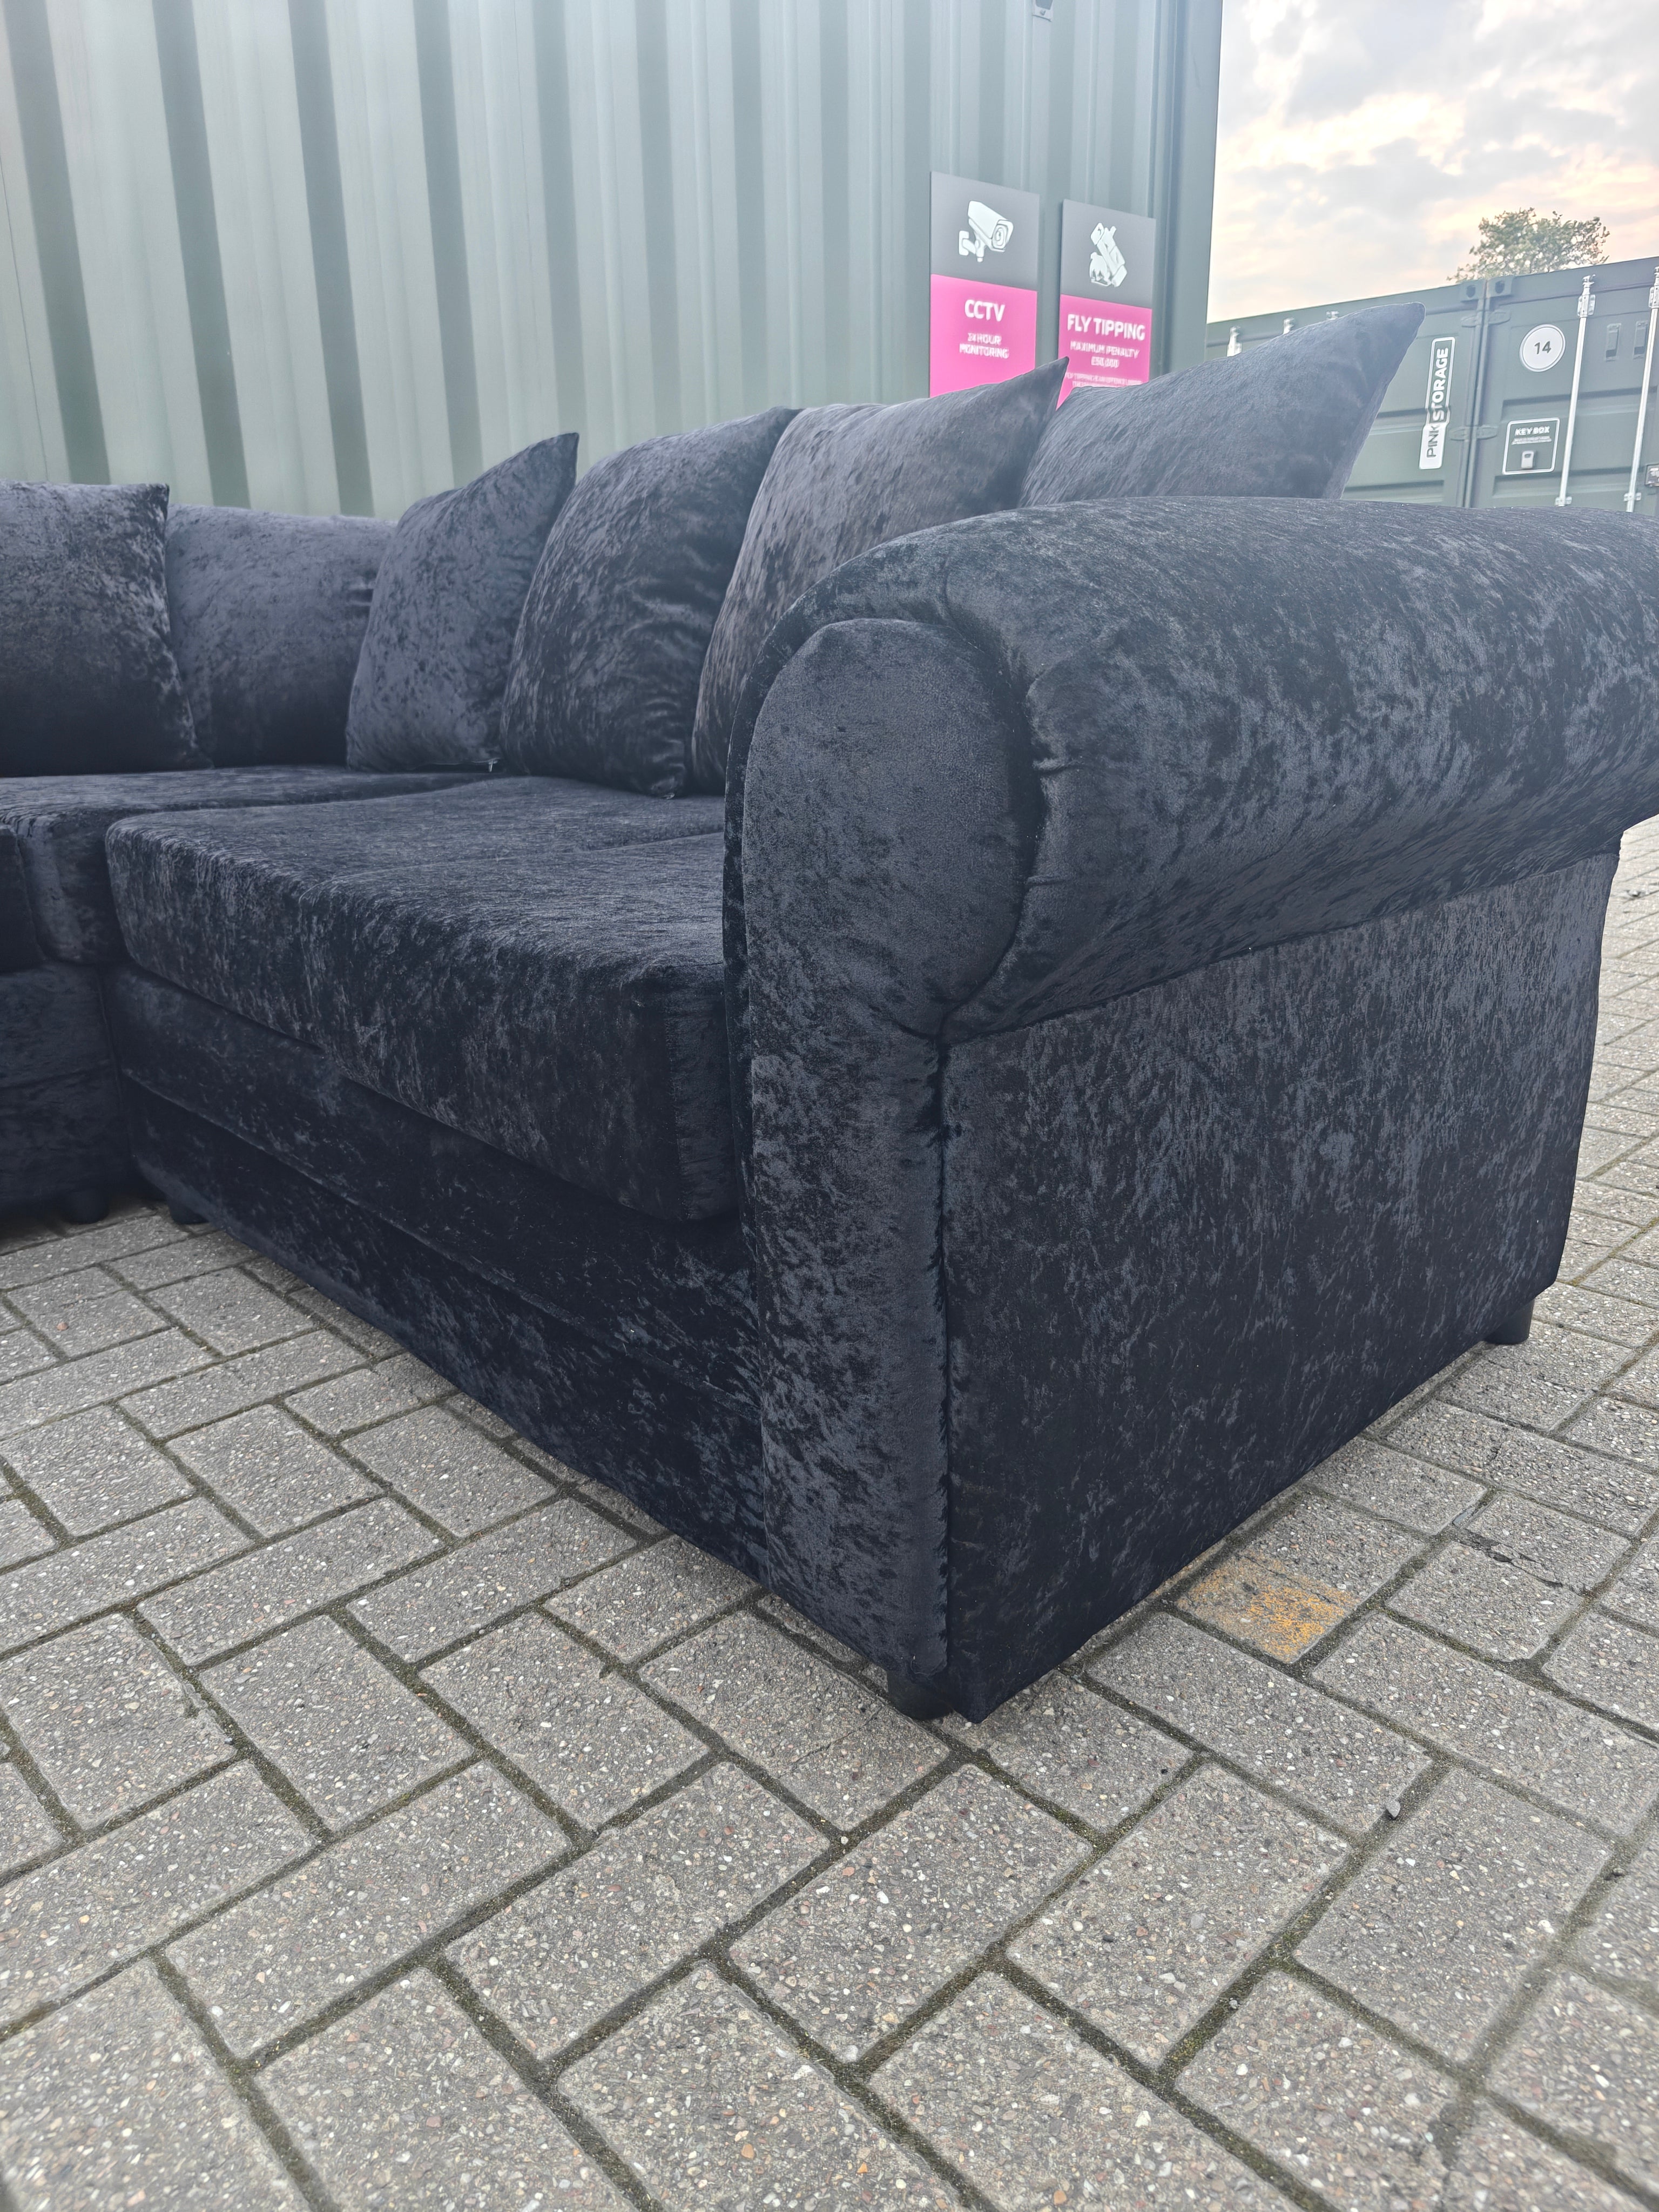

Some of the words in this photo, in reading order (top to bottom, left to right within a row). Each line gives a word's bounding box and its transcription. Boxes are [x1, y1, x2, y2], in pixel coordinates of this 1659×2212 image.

[965, 299, 1006, 322] CCTV
[1067, 313, 1092, 333] FLY
[1093, 318, 1146, 341] TIPPING
[976, 333, 1002, 346] HOUR
[1534, 341, 1552, 354] 14
[959, 343, 1009, 359] MONITORING
[1070, 341, 1106, 354] MAXIMUM
[1106, 346, 1141, 359] PENALTY
[1431, 347, 1449, 422] STORAGE
[1514, 427, 1533, 436] KEY
[1532, 426, 1550, 435] BOX
[1426, 424, 1440, 458] PINK
